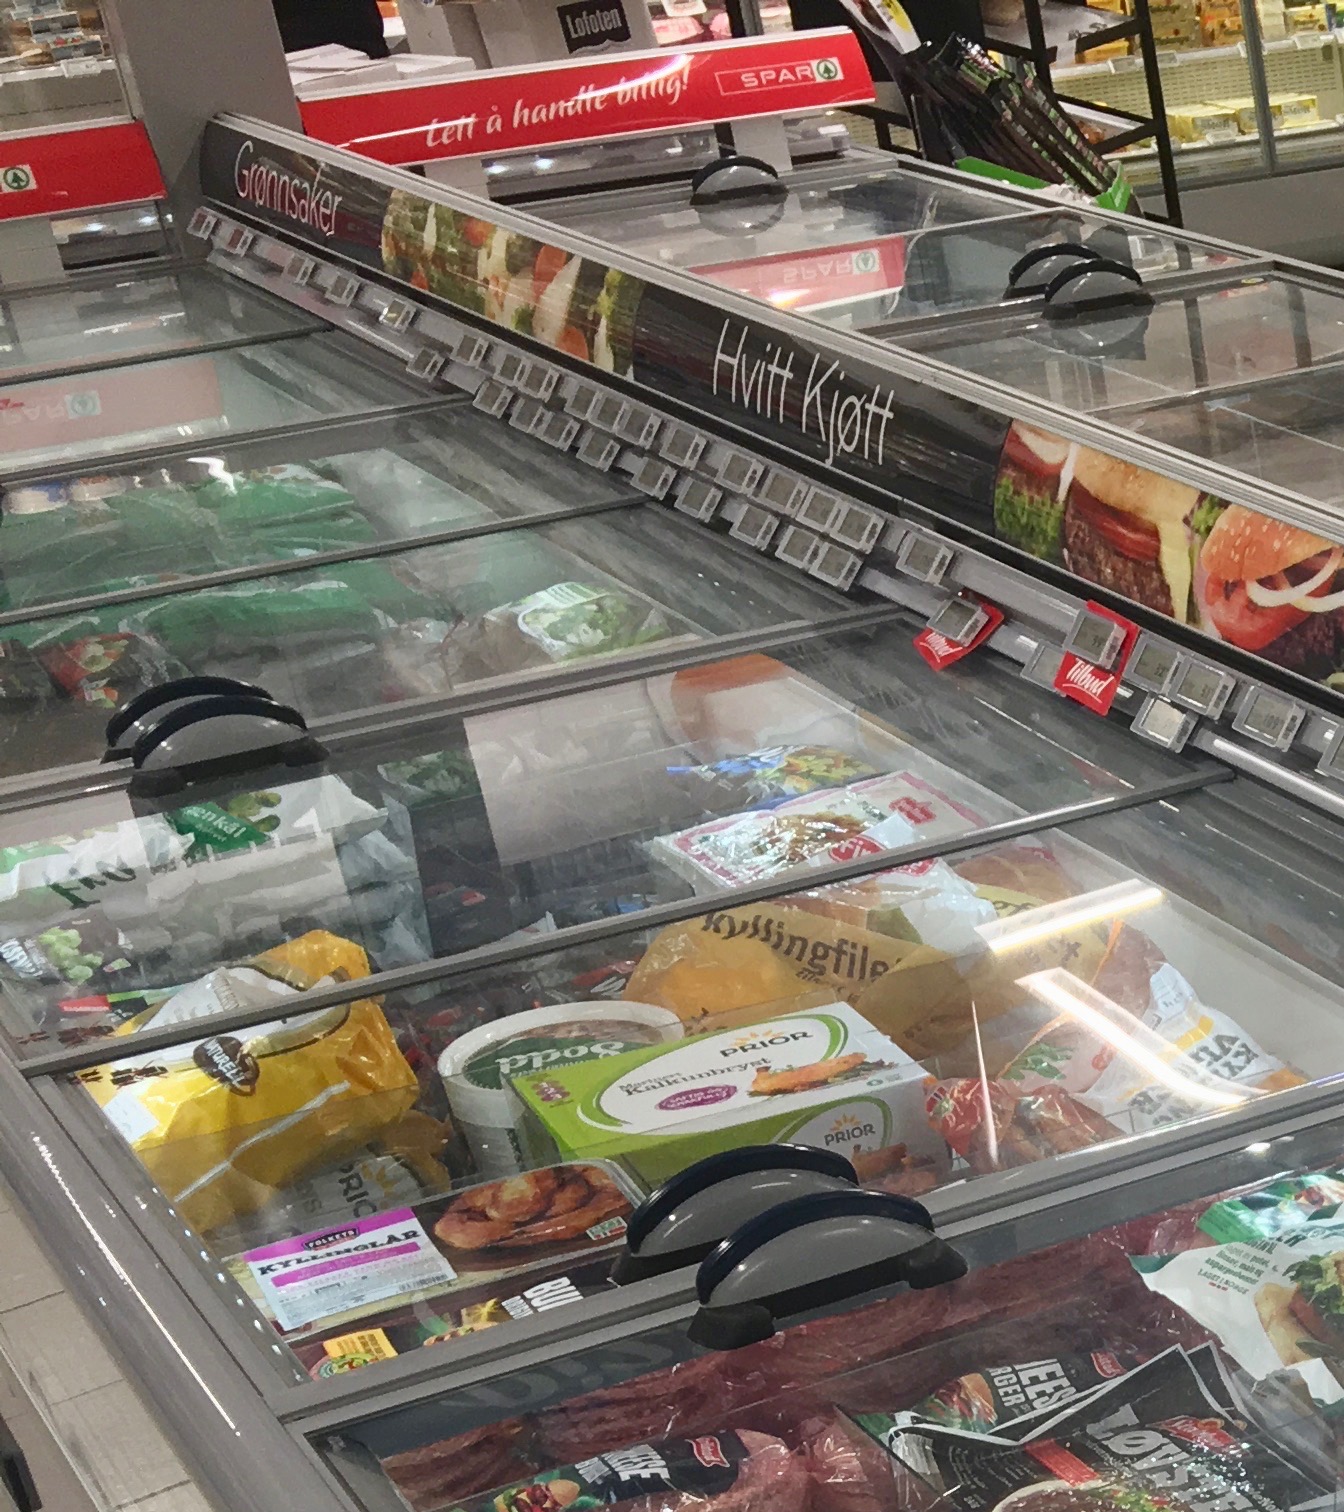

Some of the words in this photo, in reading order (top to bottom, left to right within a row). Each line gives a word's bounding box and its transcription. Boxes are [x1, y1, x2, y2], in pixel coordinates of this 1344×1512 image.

[567, 8, 622, 39] Lofoten
[740, 65, 813, 89] SPAR
[512, 83, 607, 129] handle
[234, 140, 343, 237] Grønnsaker
[713, 318, 794, 424] Hvitt
[801, 352, 894, 466] Kjøtt
[1066, 658, 1115, 697] Tilbud
[719, 1031, 813, 1058] PRIOR
[824, 1123, 876, 1147] PRIOR
